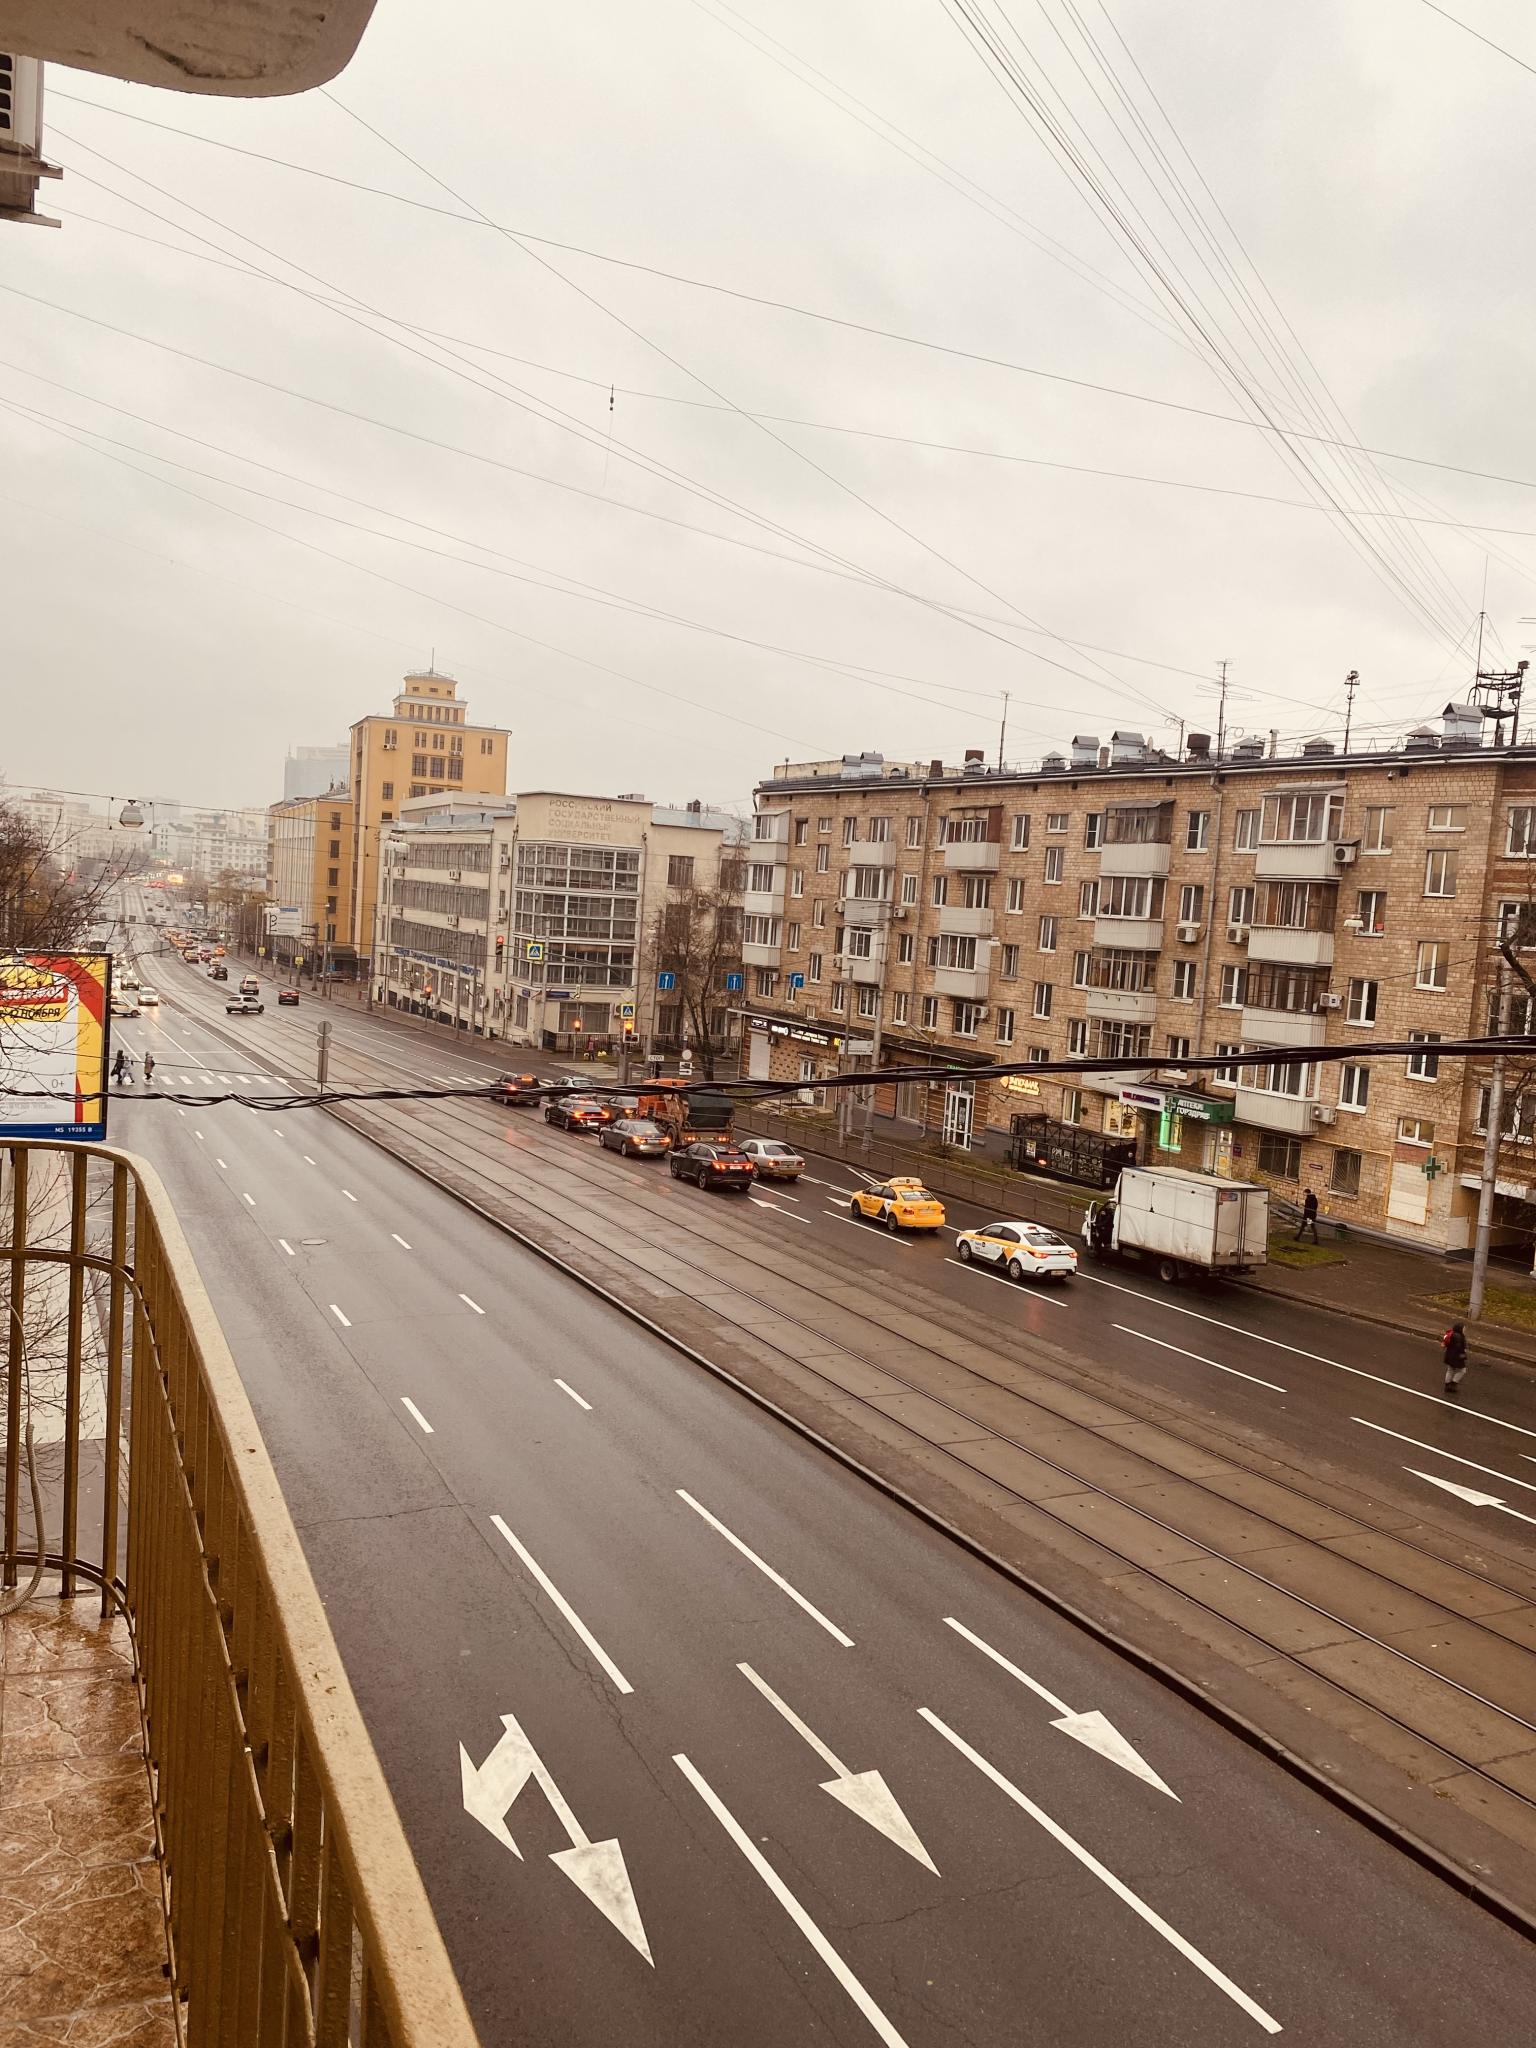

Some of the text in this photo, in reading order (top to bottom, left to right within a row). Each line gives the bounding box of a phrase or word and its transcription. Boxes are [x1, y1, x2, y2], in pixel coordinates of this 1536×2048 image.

[549, 799, 612, 812] РОСССКИЙ
[548, 809, 640, 824] ГОСУДАРСТВЕННЫЙ
[21, 1007, 61, 1019] НОЯБРЯ
[51, 1078, 64, 1089] 0+
[1177, 1099, 1205, 1111] АПТЕКИ
